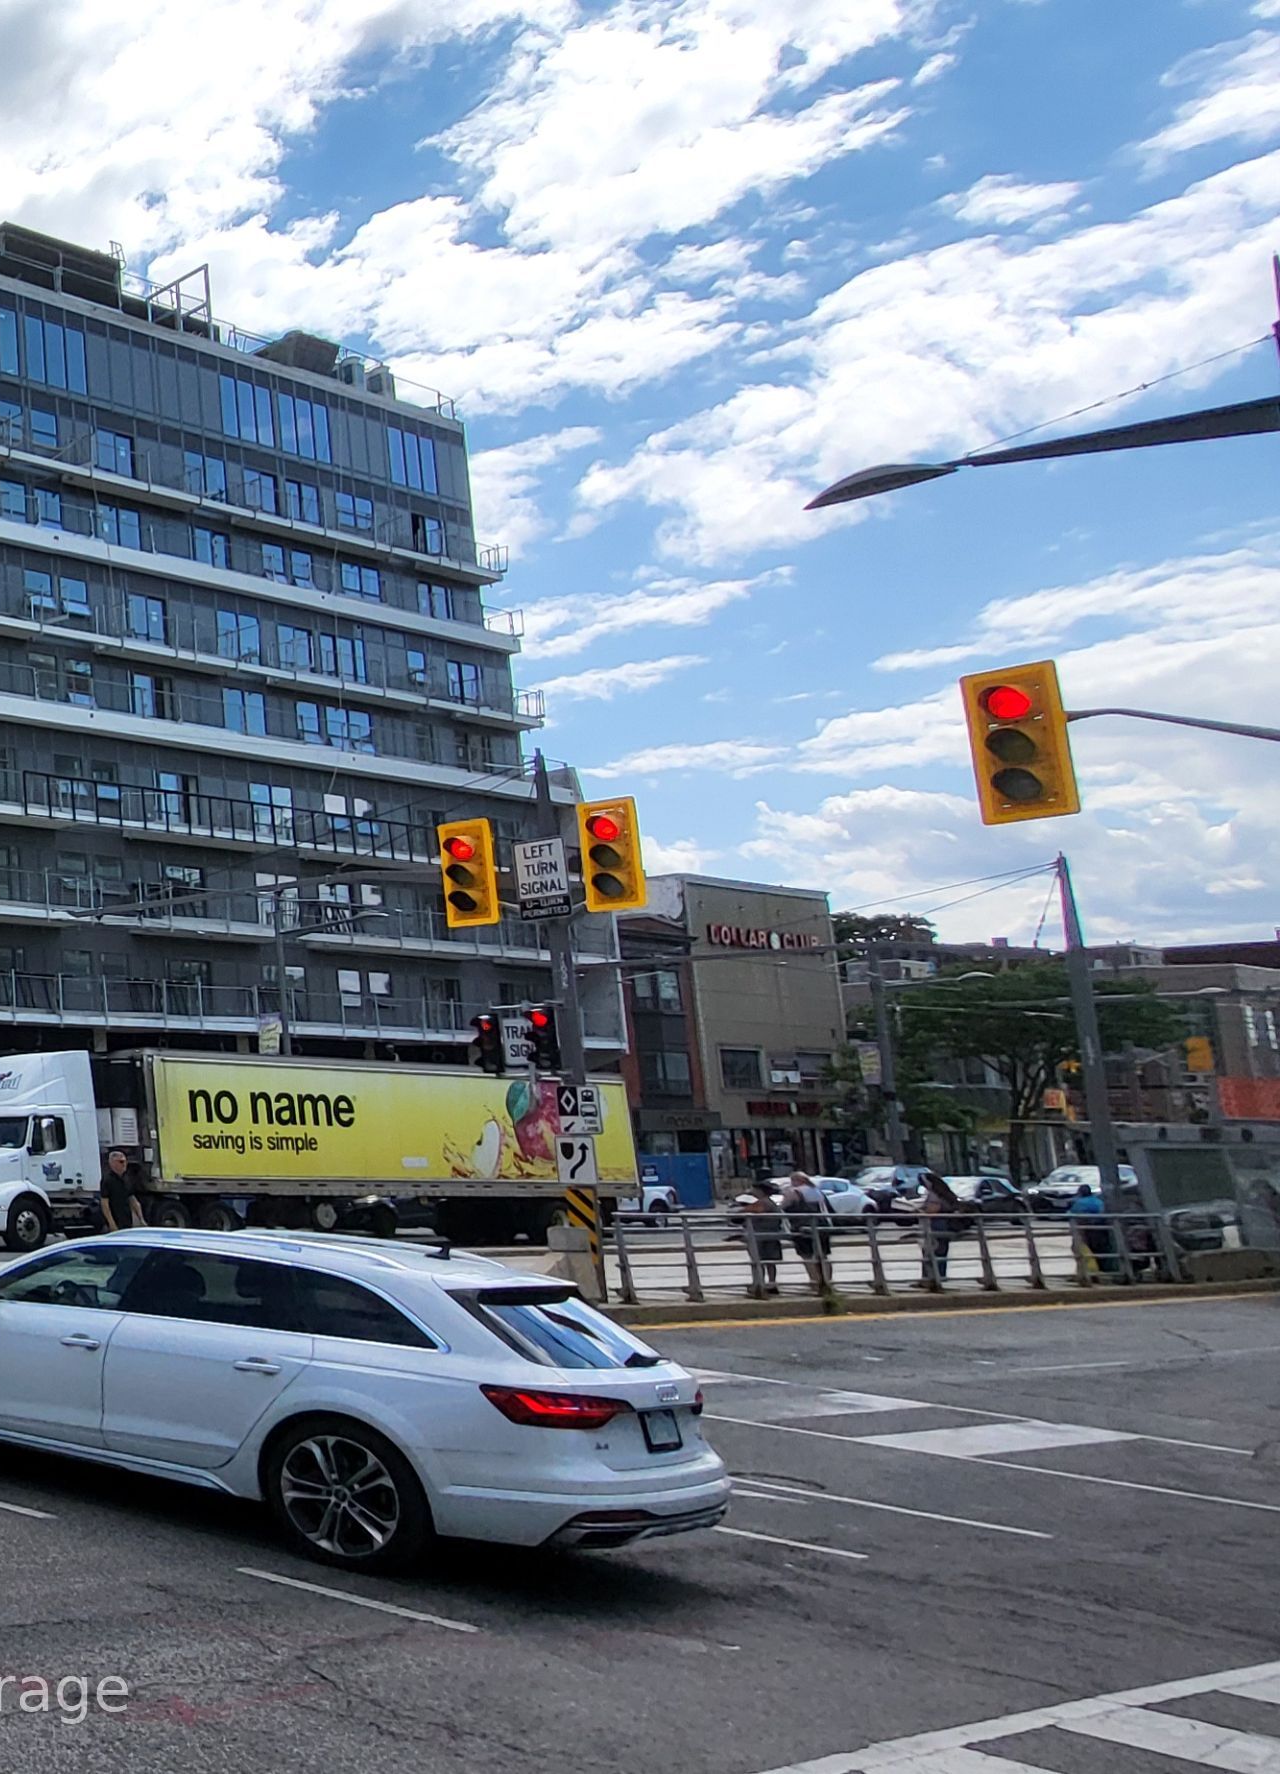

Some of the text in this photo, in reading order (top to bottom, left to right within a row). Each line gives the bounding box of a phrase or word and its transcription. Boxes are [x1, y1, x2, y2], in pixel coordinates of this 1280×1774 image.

[522, 843, 553, 860] LEFT
[523, 861, 559, 877] TURN
[520, 878, 566, 896] SIGNAL
[525, 897, 564, 909] U-TURN
[522, 905, 570, 919] PERMITTED
[708, 924, 768, 949] DOLLAR
[188, 1089, 356, 1128] no name
[192, 1130, 318, 1156] saving is simple
